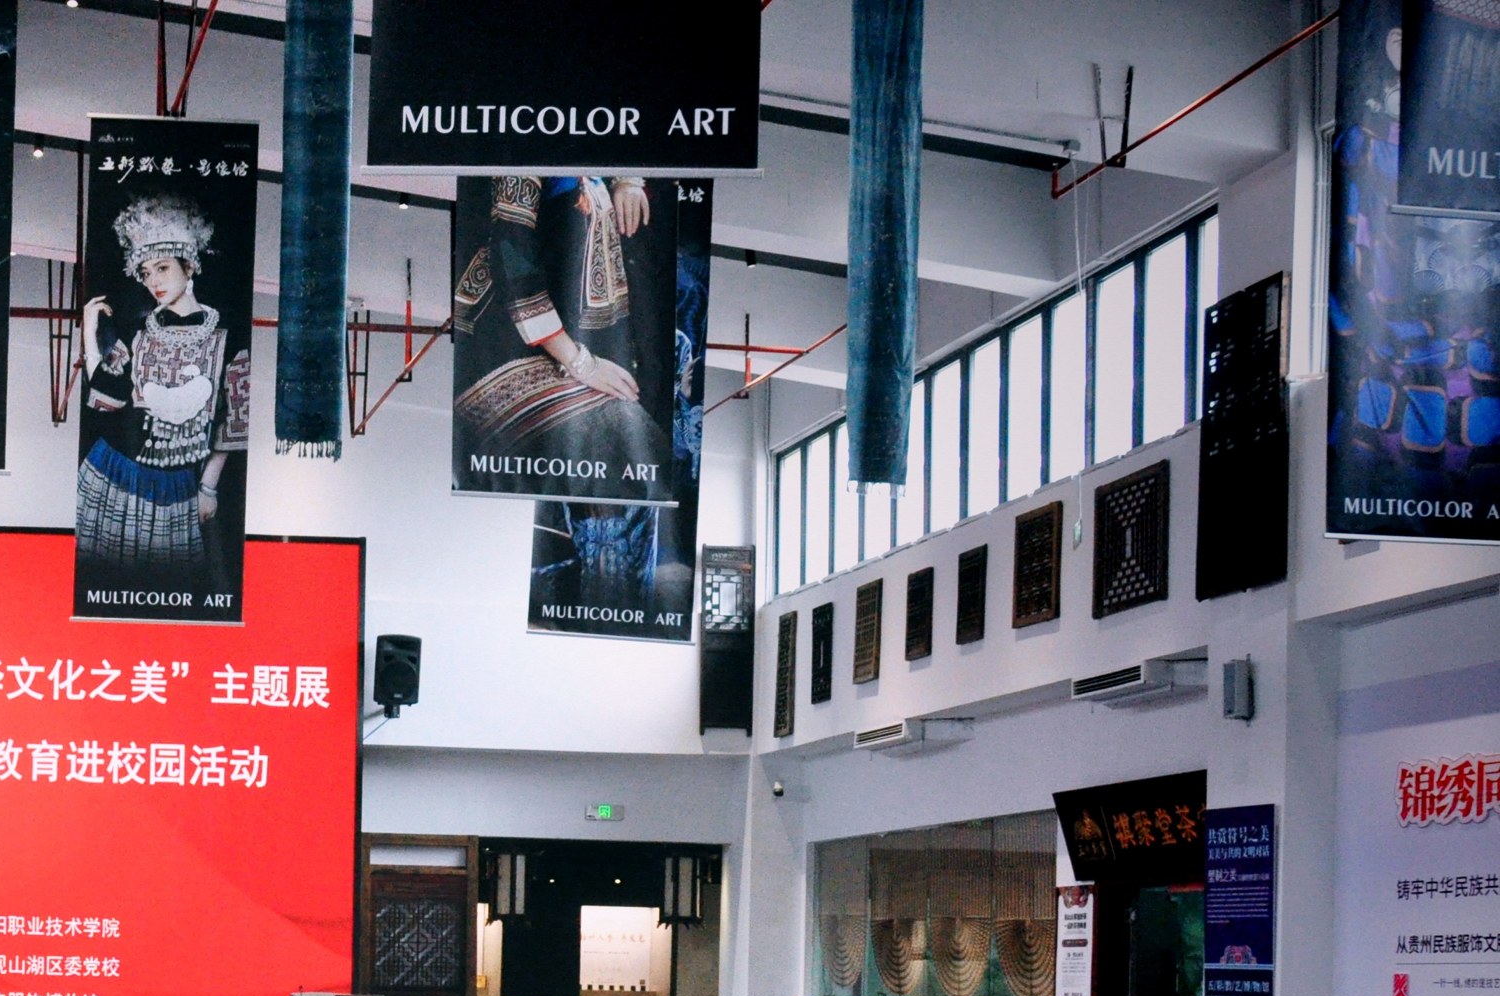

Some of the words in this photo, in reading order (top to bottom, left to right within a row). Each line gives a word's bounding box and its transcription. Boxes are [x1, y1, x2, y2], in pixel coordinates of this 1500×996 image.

[401, 105, 640, 136] MULTICOLOR
[667, 107, 736, 136] ART
[1427, 146, 1500, 179] MUL
[470, 454, 607, 479] MULTICOLOR
[621, 463, 659, 482] ART
[1344, 497, 1474, 519] MULTICOLOR
[87, 590, 193, 607] MULTICOLOR
[203, 593, 233, 608] ART
[542, 604, 645, 624] MULTICOLOR
[655, 612, 683, 627] ART
[210, 663, 331, 709] 主题展
[1396, 933, 1500, 955] 从贵州民族服饰文
